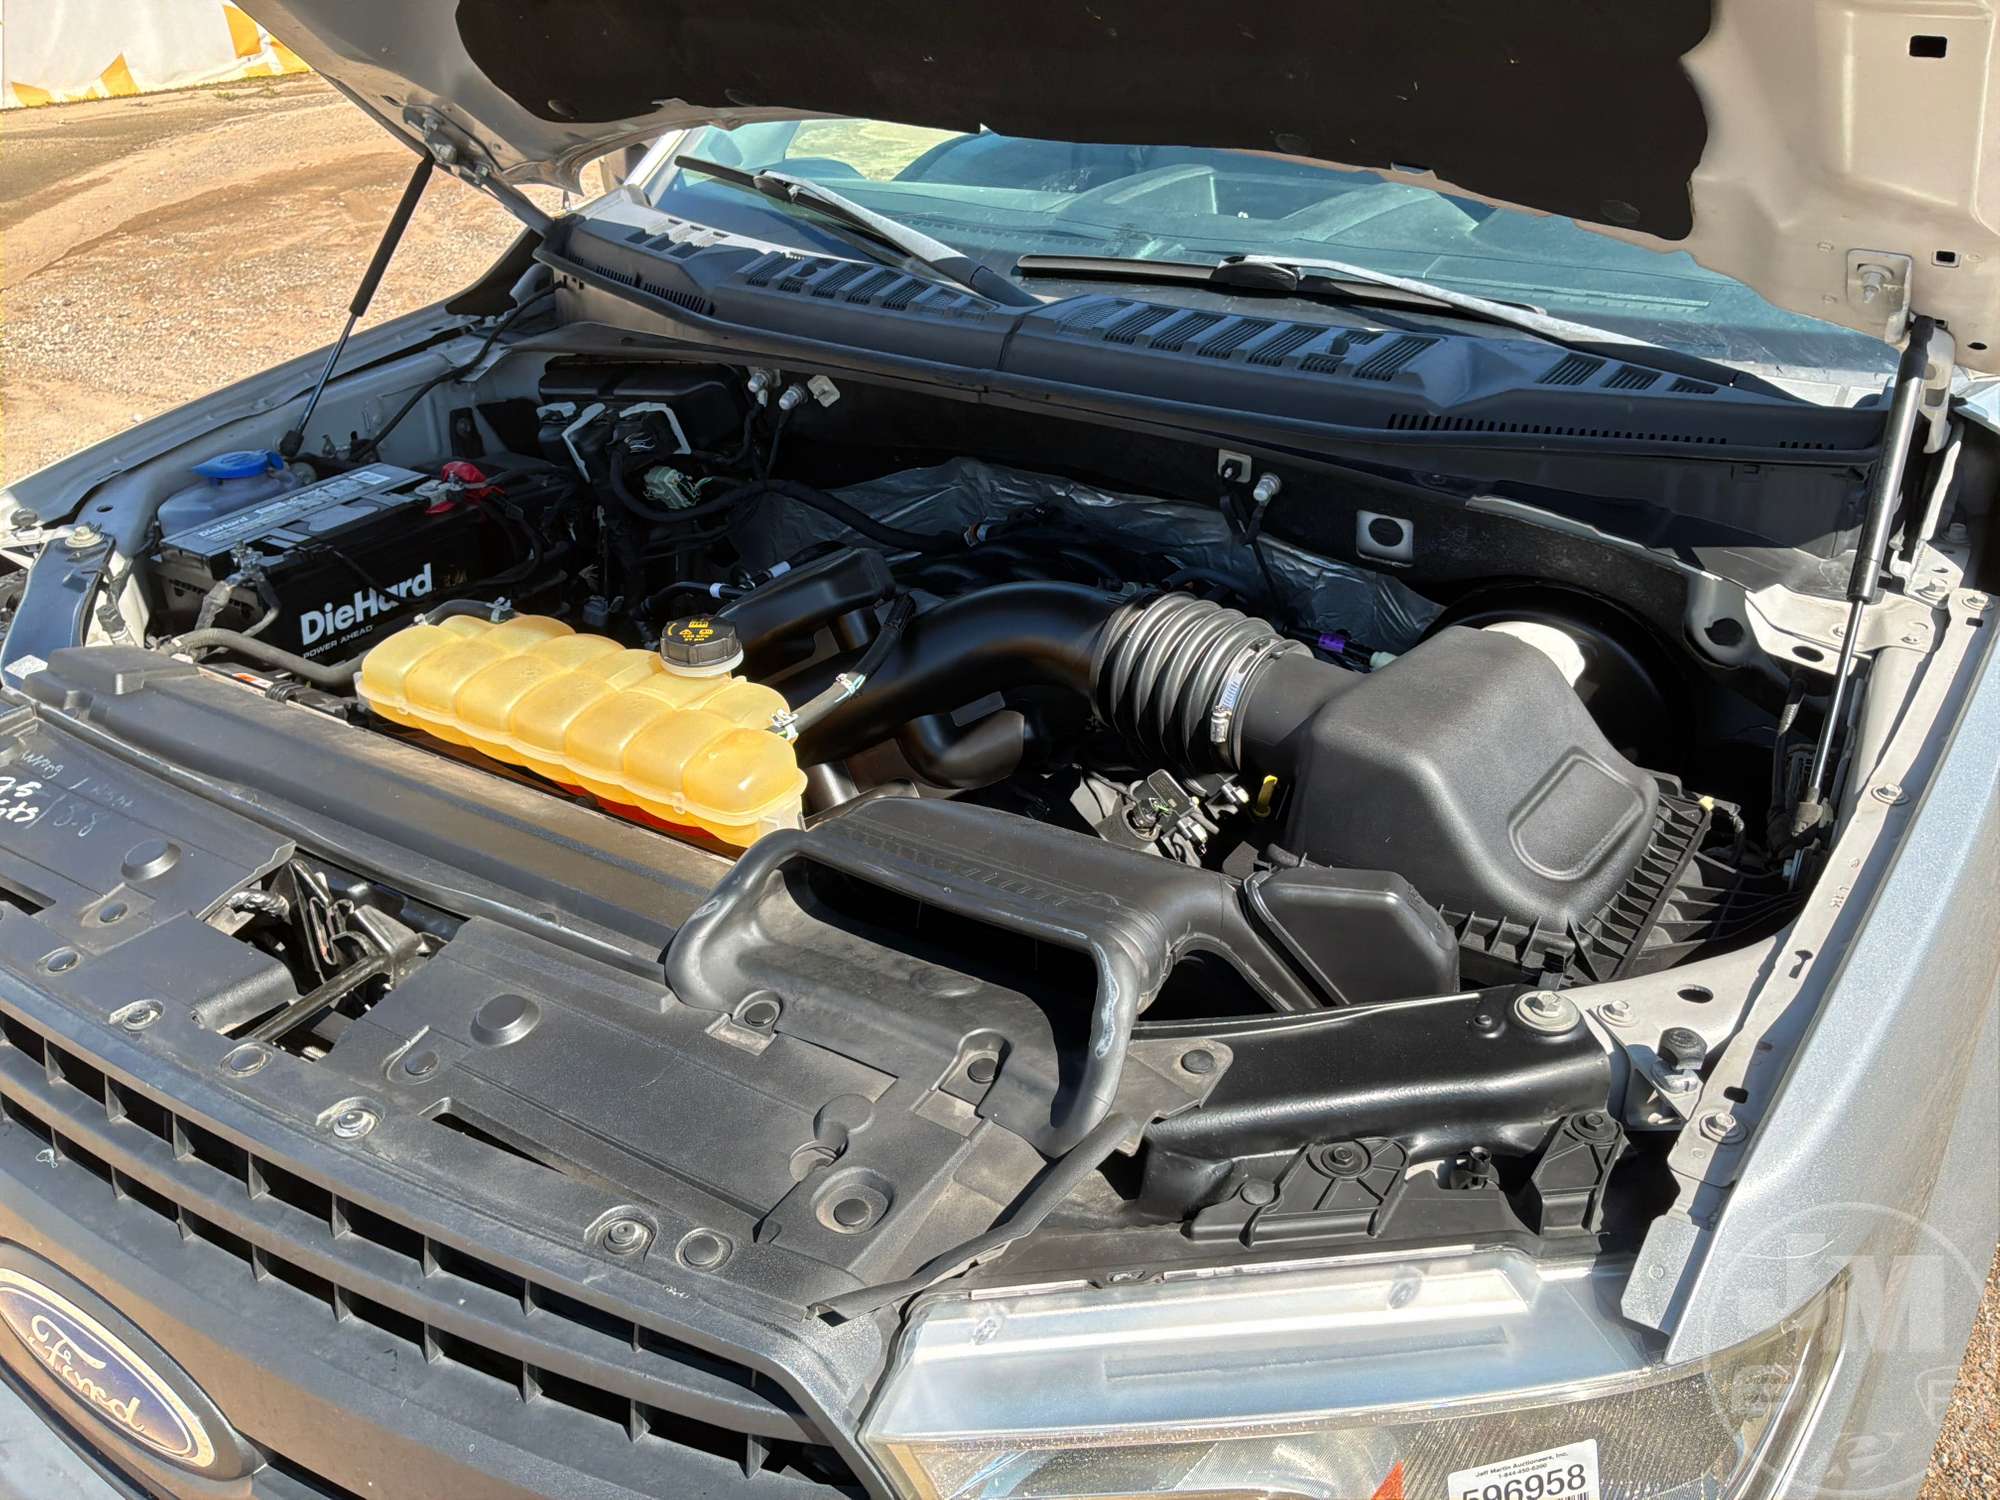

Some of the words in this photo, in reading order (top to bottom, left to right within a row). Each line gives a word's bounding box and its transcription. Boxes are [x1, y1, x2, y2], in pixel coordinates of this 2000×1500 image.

[300, 562, 433, 646] DieHard
[303, 640, 338, 660] POWER
[340, 624, 374, 645] AHEAD
[28, 1314, 145, 1433] Ford
[1475, 1470, 1489, 1478] Jeff
[1490, 1464, 1512, 1474] Martin
[1512, 1454, 1555, 1469] Auctioneers,
